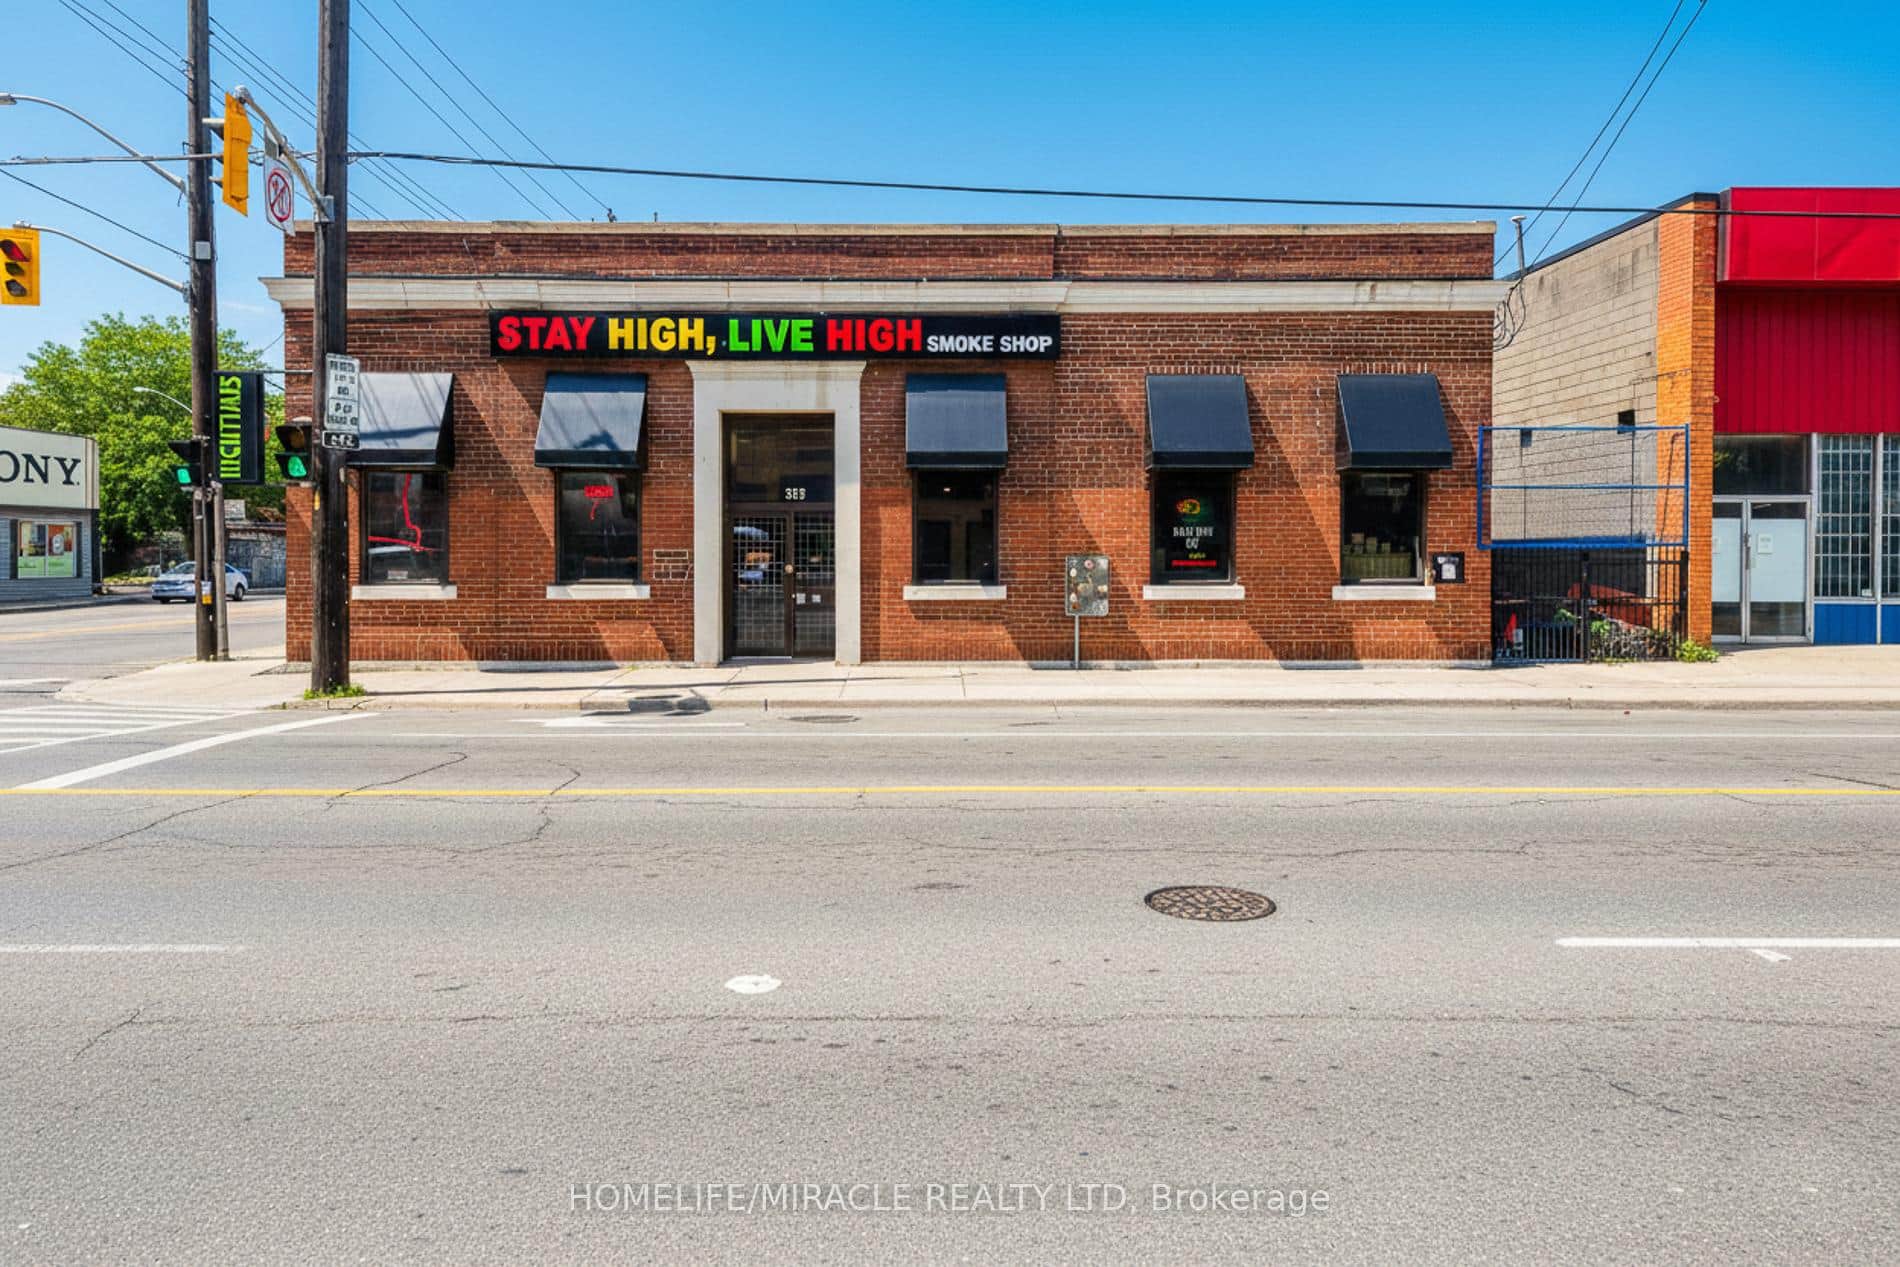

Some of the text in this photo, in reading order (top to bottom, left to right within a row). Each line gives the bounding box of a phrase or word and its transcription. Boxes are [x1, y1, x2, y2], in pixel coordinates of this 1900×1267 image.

[498, 316, 1053, 356] STAY HIGH, LIVE HIGH SMOKE SHOP
